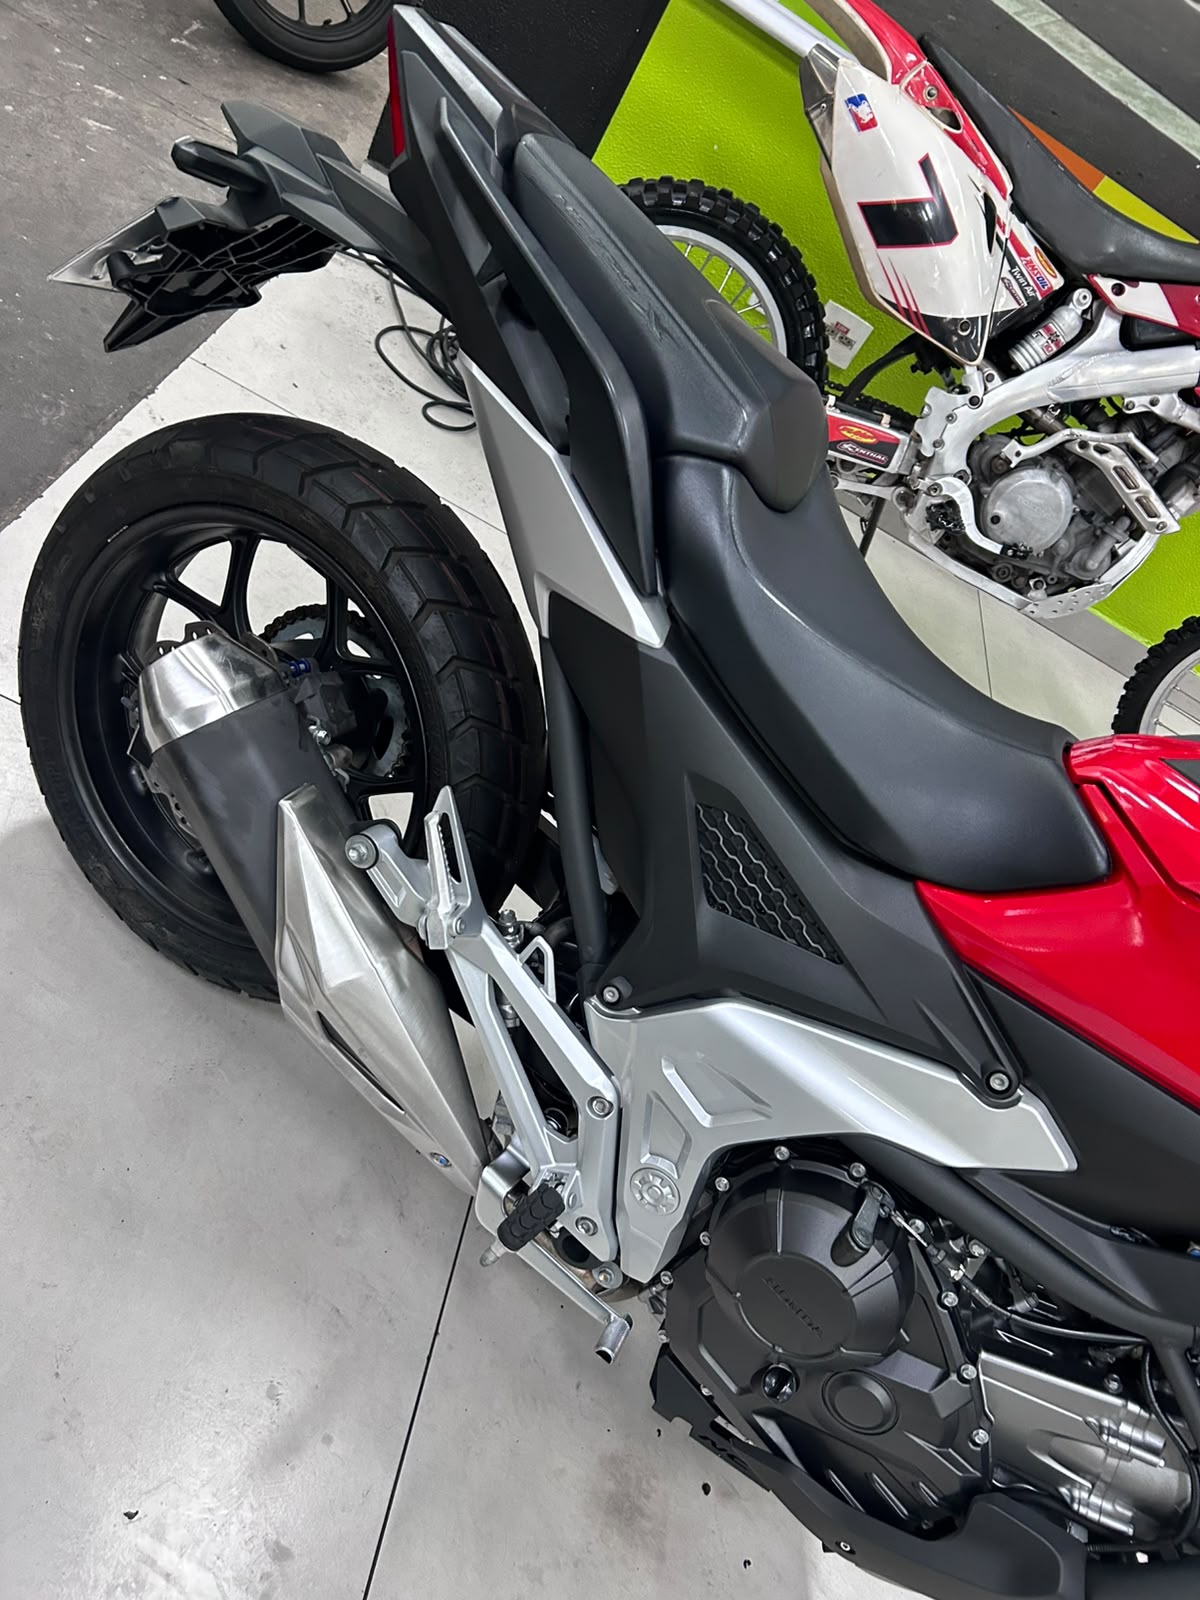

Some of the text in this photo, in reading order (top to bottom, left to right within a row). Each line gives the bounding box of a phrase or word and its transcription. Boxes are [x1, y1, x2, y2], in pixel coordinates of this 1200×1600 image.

[1011, 266, 1028, 287] Twin
[1024, 285, 1036, 297] Air
[1020, 256, 1049, 290] AMSOIL
[761, 1277, 823, 1340] HONDA
